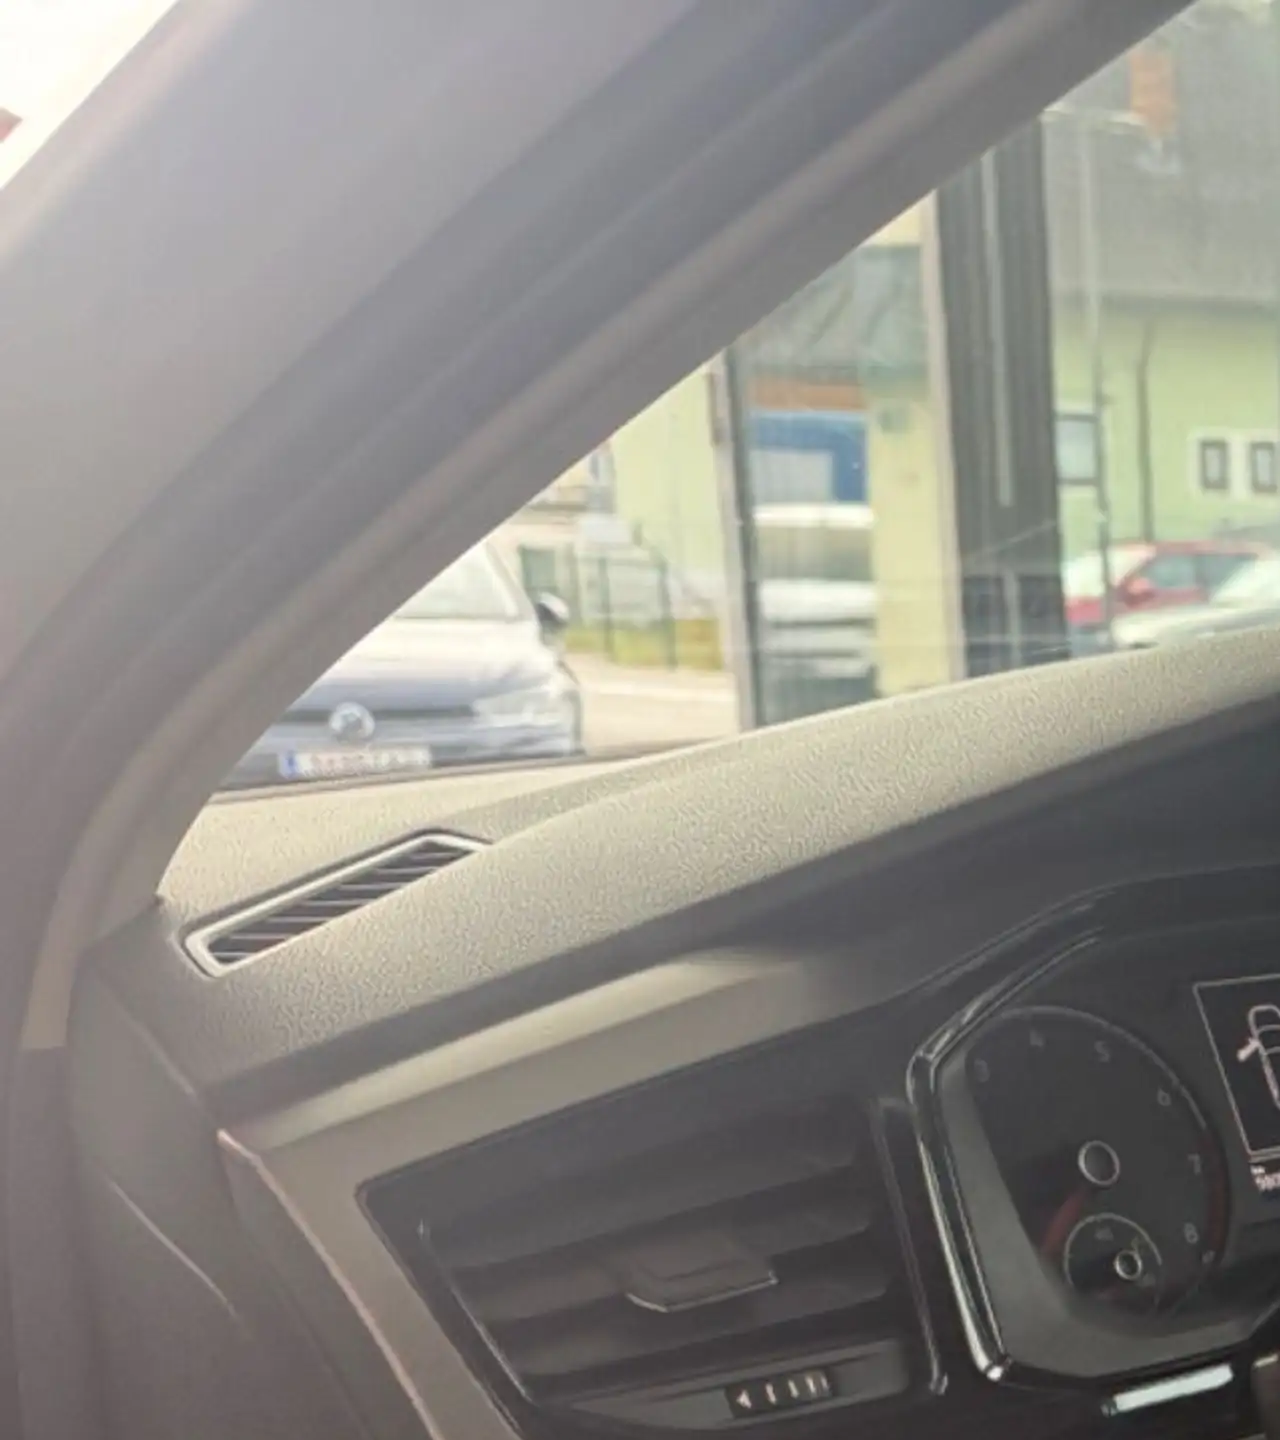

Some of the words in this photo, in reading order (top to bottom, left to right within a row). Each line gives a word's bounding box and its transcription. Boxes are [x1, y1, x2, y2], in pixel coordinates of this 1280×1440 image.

[1095, 1040, 1110, 1063] 5
[1157, 1085, 1171, 1106] 6
[1187, 1153, 1201, 1175] 7
[1183, 1222, 1198, 1244] 8
